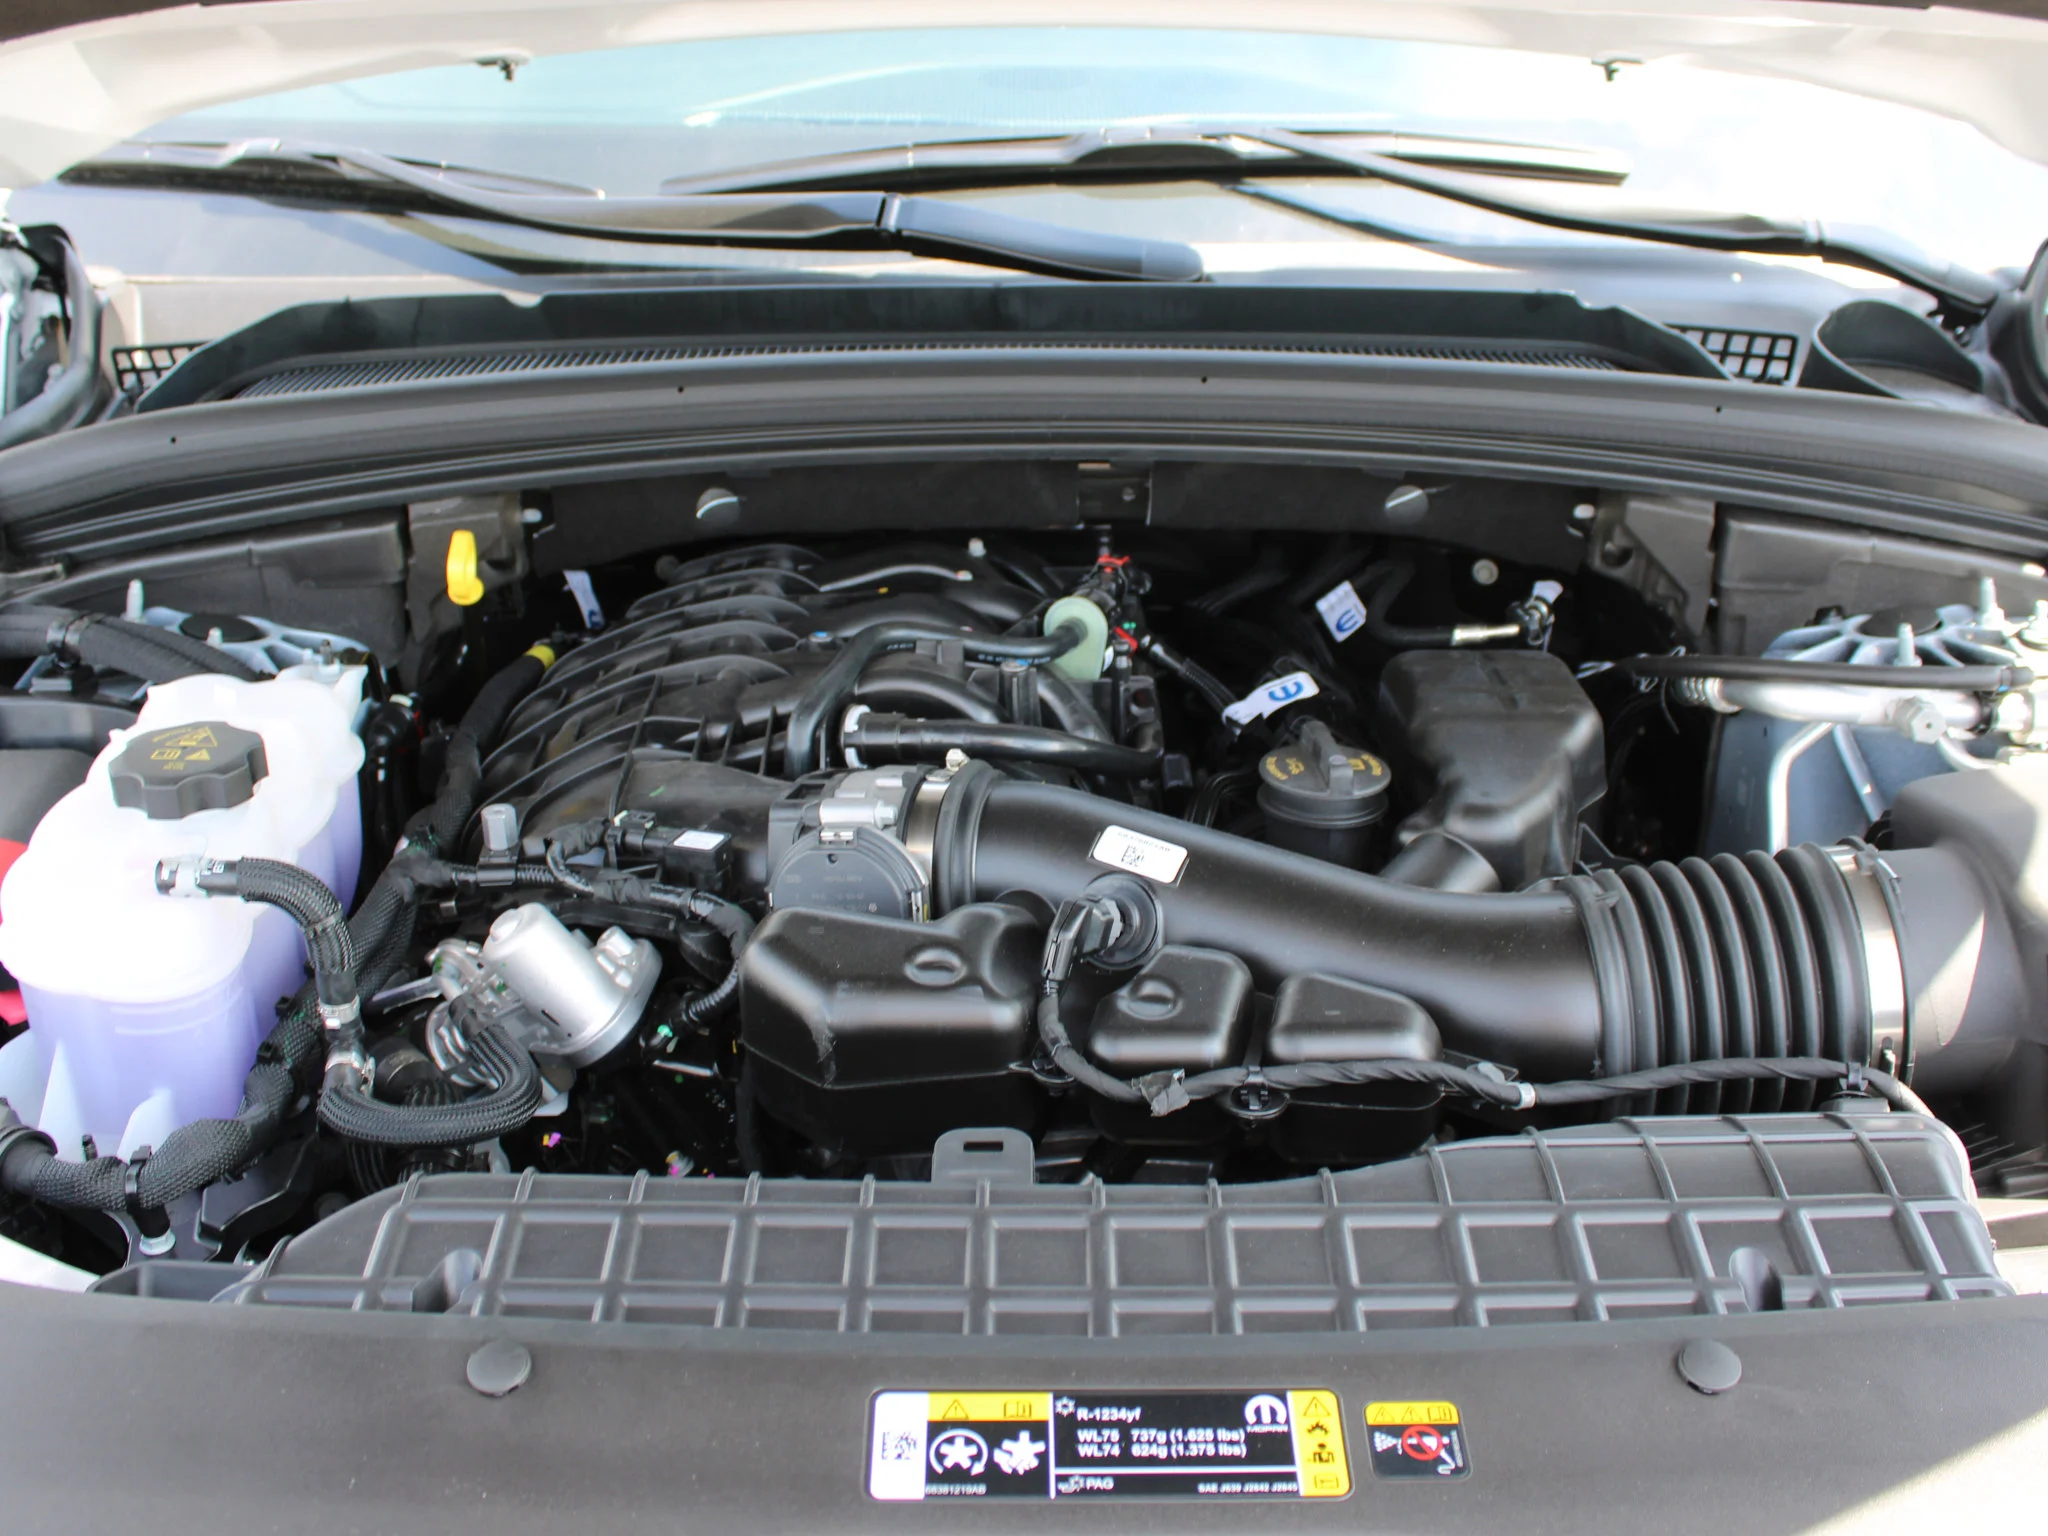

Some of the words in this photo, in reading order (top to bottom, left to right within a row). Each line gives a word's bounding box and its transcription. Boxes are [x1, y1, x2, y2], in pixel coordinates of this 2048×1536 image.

[1076, 1407, 1141, 1423] R-1234yf
[1130, 1428, 1167, 1445] 737g
[1216, 1428, 1246, 1444] lbs)
[1077, 1443, 1121, 1458] WL74
[1131, 1443, 1168, 1460] 624g
[1217, 1442, 1248, 1459] lbs)
[1085, 1477, 1115, 1490] PAG
